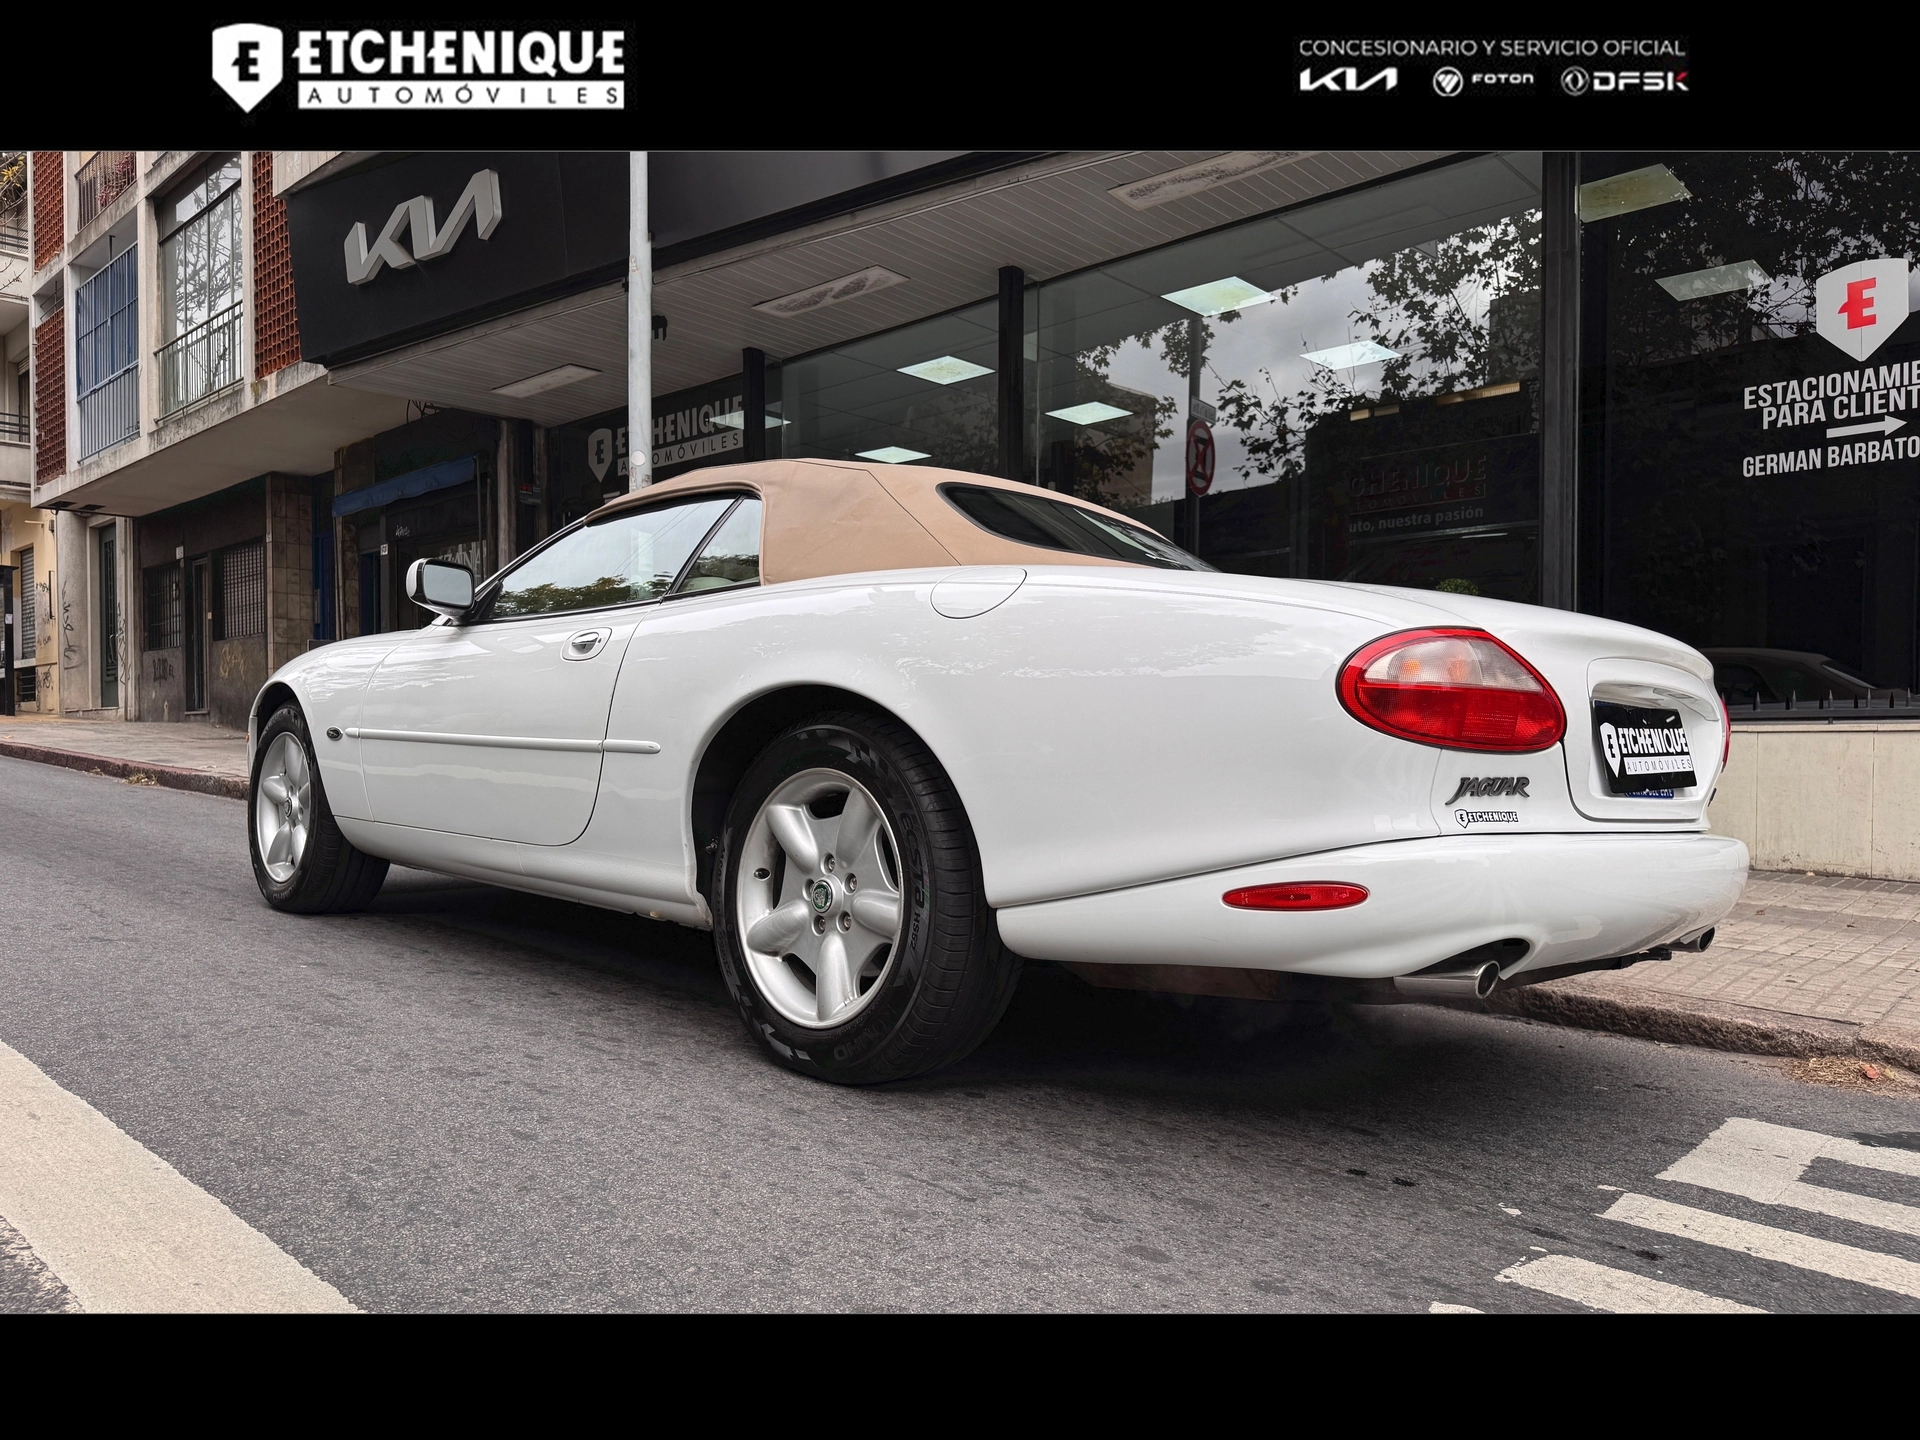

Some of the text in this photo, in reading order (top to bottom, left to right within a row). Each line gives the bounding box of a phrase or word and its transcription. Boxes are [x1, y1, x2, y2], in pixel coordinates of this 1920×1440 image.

[344, 168, 502, 286] KIA
[615, 395, 743, 454] EHENIQUE
[1762, 399, 1827, 430] PARA
[620, 432, 739, 472] AOMÓVILES
[1742, 435, 1920, 478] GERMAN BARBATO
[1378, 513, 1431, 530] nuestra
[1435, 506, 1484, 526] pasión
[1617, 727, 1689, 754] ETCHENIQUE
[1627, 758, 1692, 772] AUTOMÓVILES
[1444, 777, 1530, 805] JAGUAR
[1468, 811, 1519, 823] ETCHENIQUE
